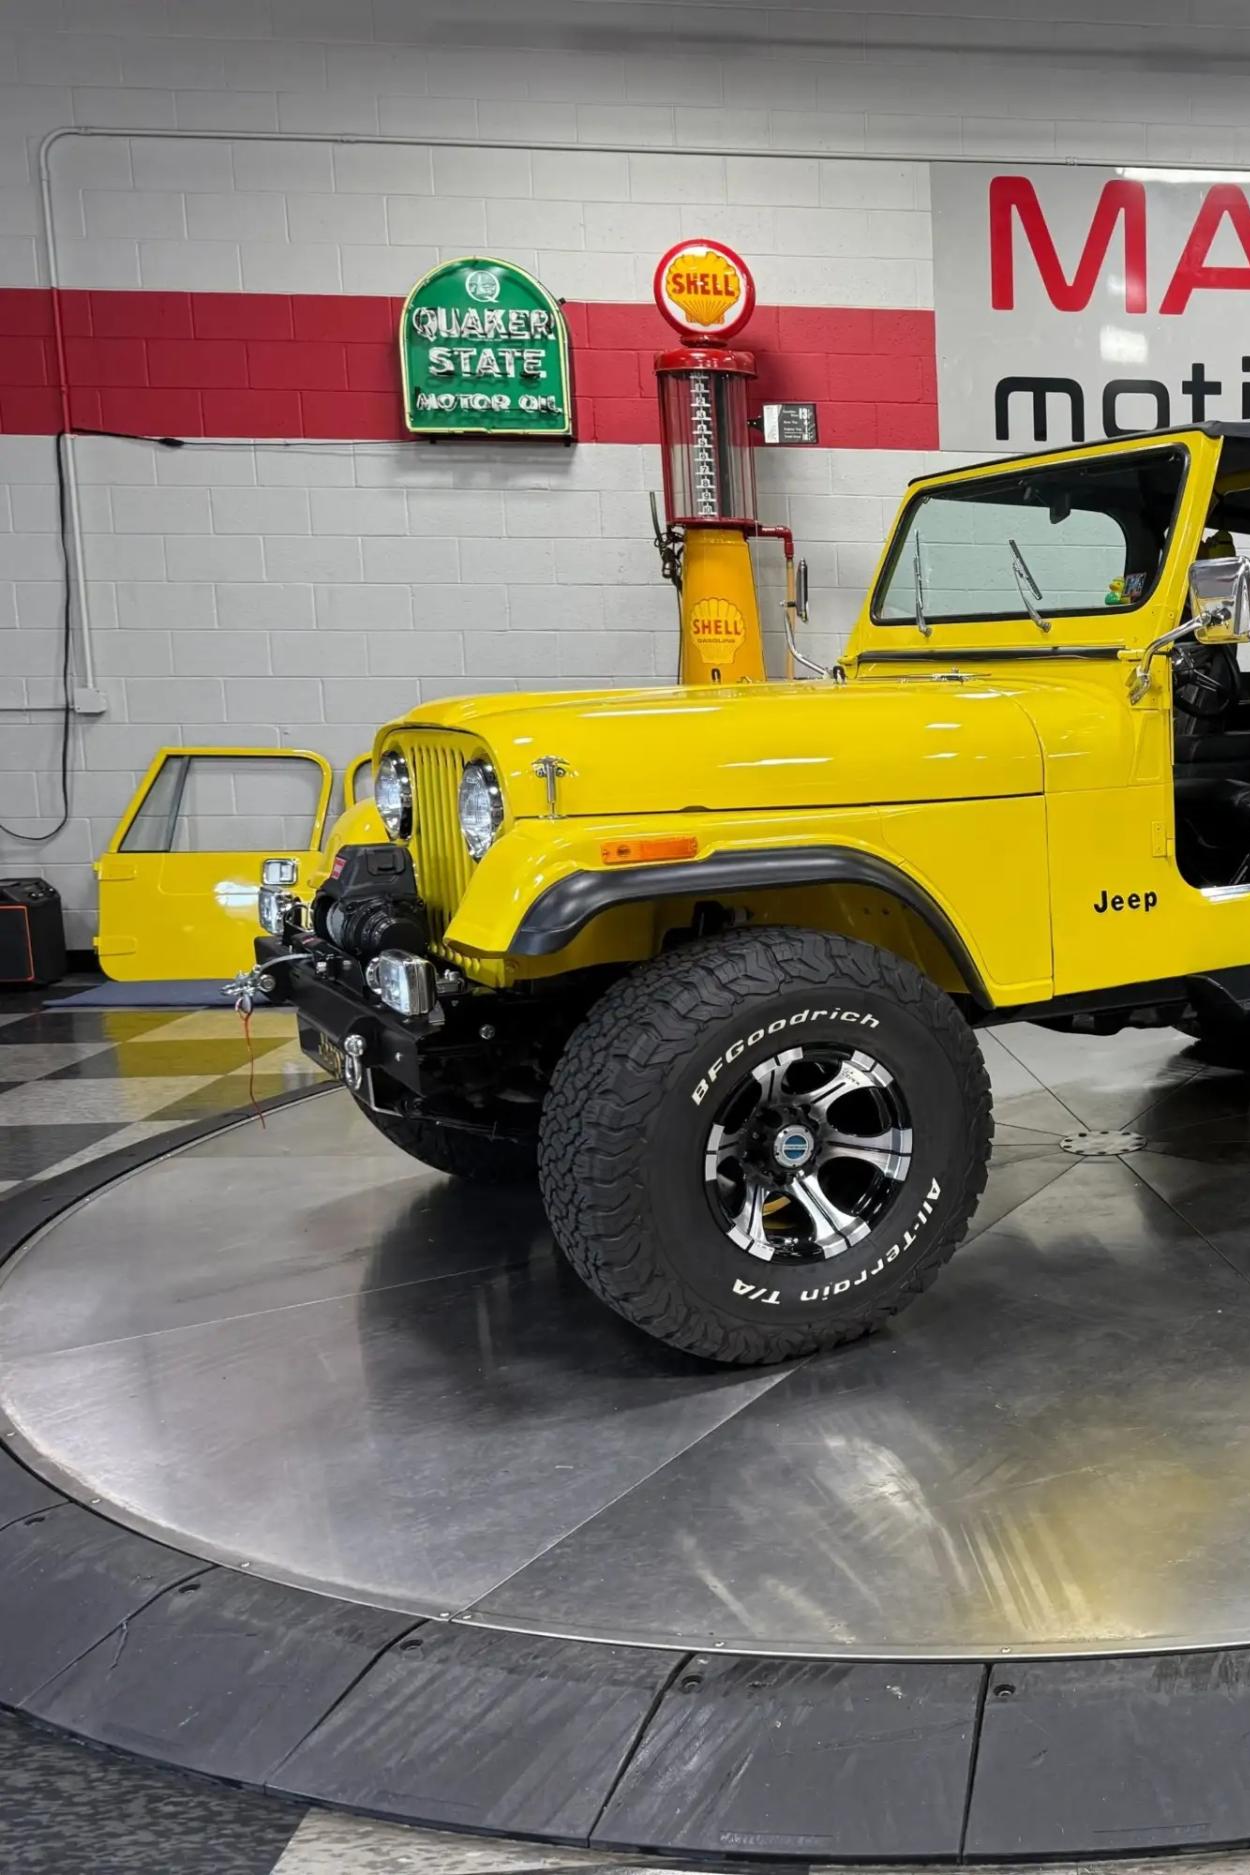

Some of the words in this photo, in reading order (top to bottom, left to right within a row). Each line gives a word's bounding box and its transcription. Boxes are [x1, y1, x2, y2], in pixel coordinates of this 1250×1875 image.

[671, 273, 735, 297] SHELL
[412, 307, 556, 341] QUAKER
[428, 347, 547, 378] STATE
[416, 393, 511, 411] MOTOR
[518, 394, 563, 414] OIL
[693, 619, 740, 635] SHELL
[1093, 890, 1157, 913] Jeep
[691, 1007, 882, 1106] BFGoodrich
[800, 1177, 942, 1302] All-Terrain
[732, 1278, 780, 1305] T/A
